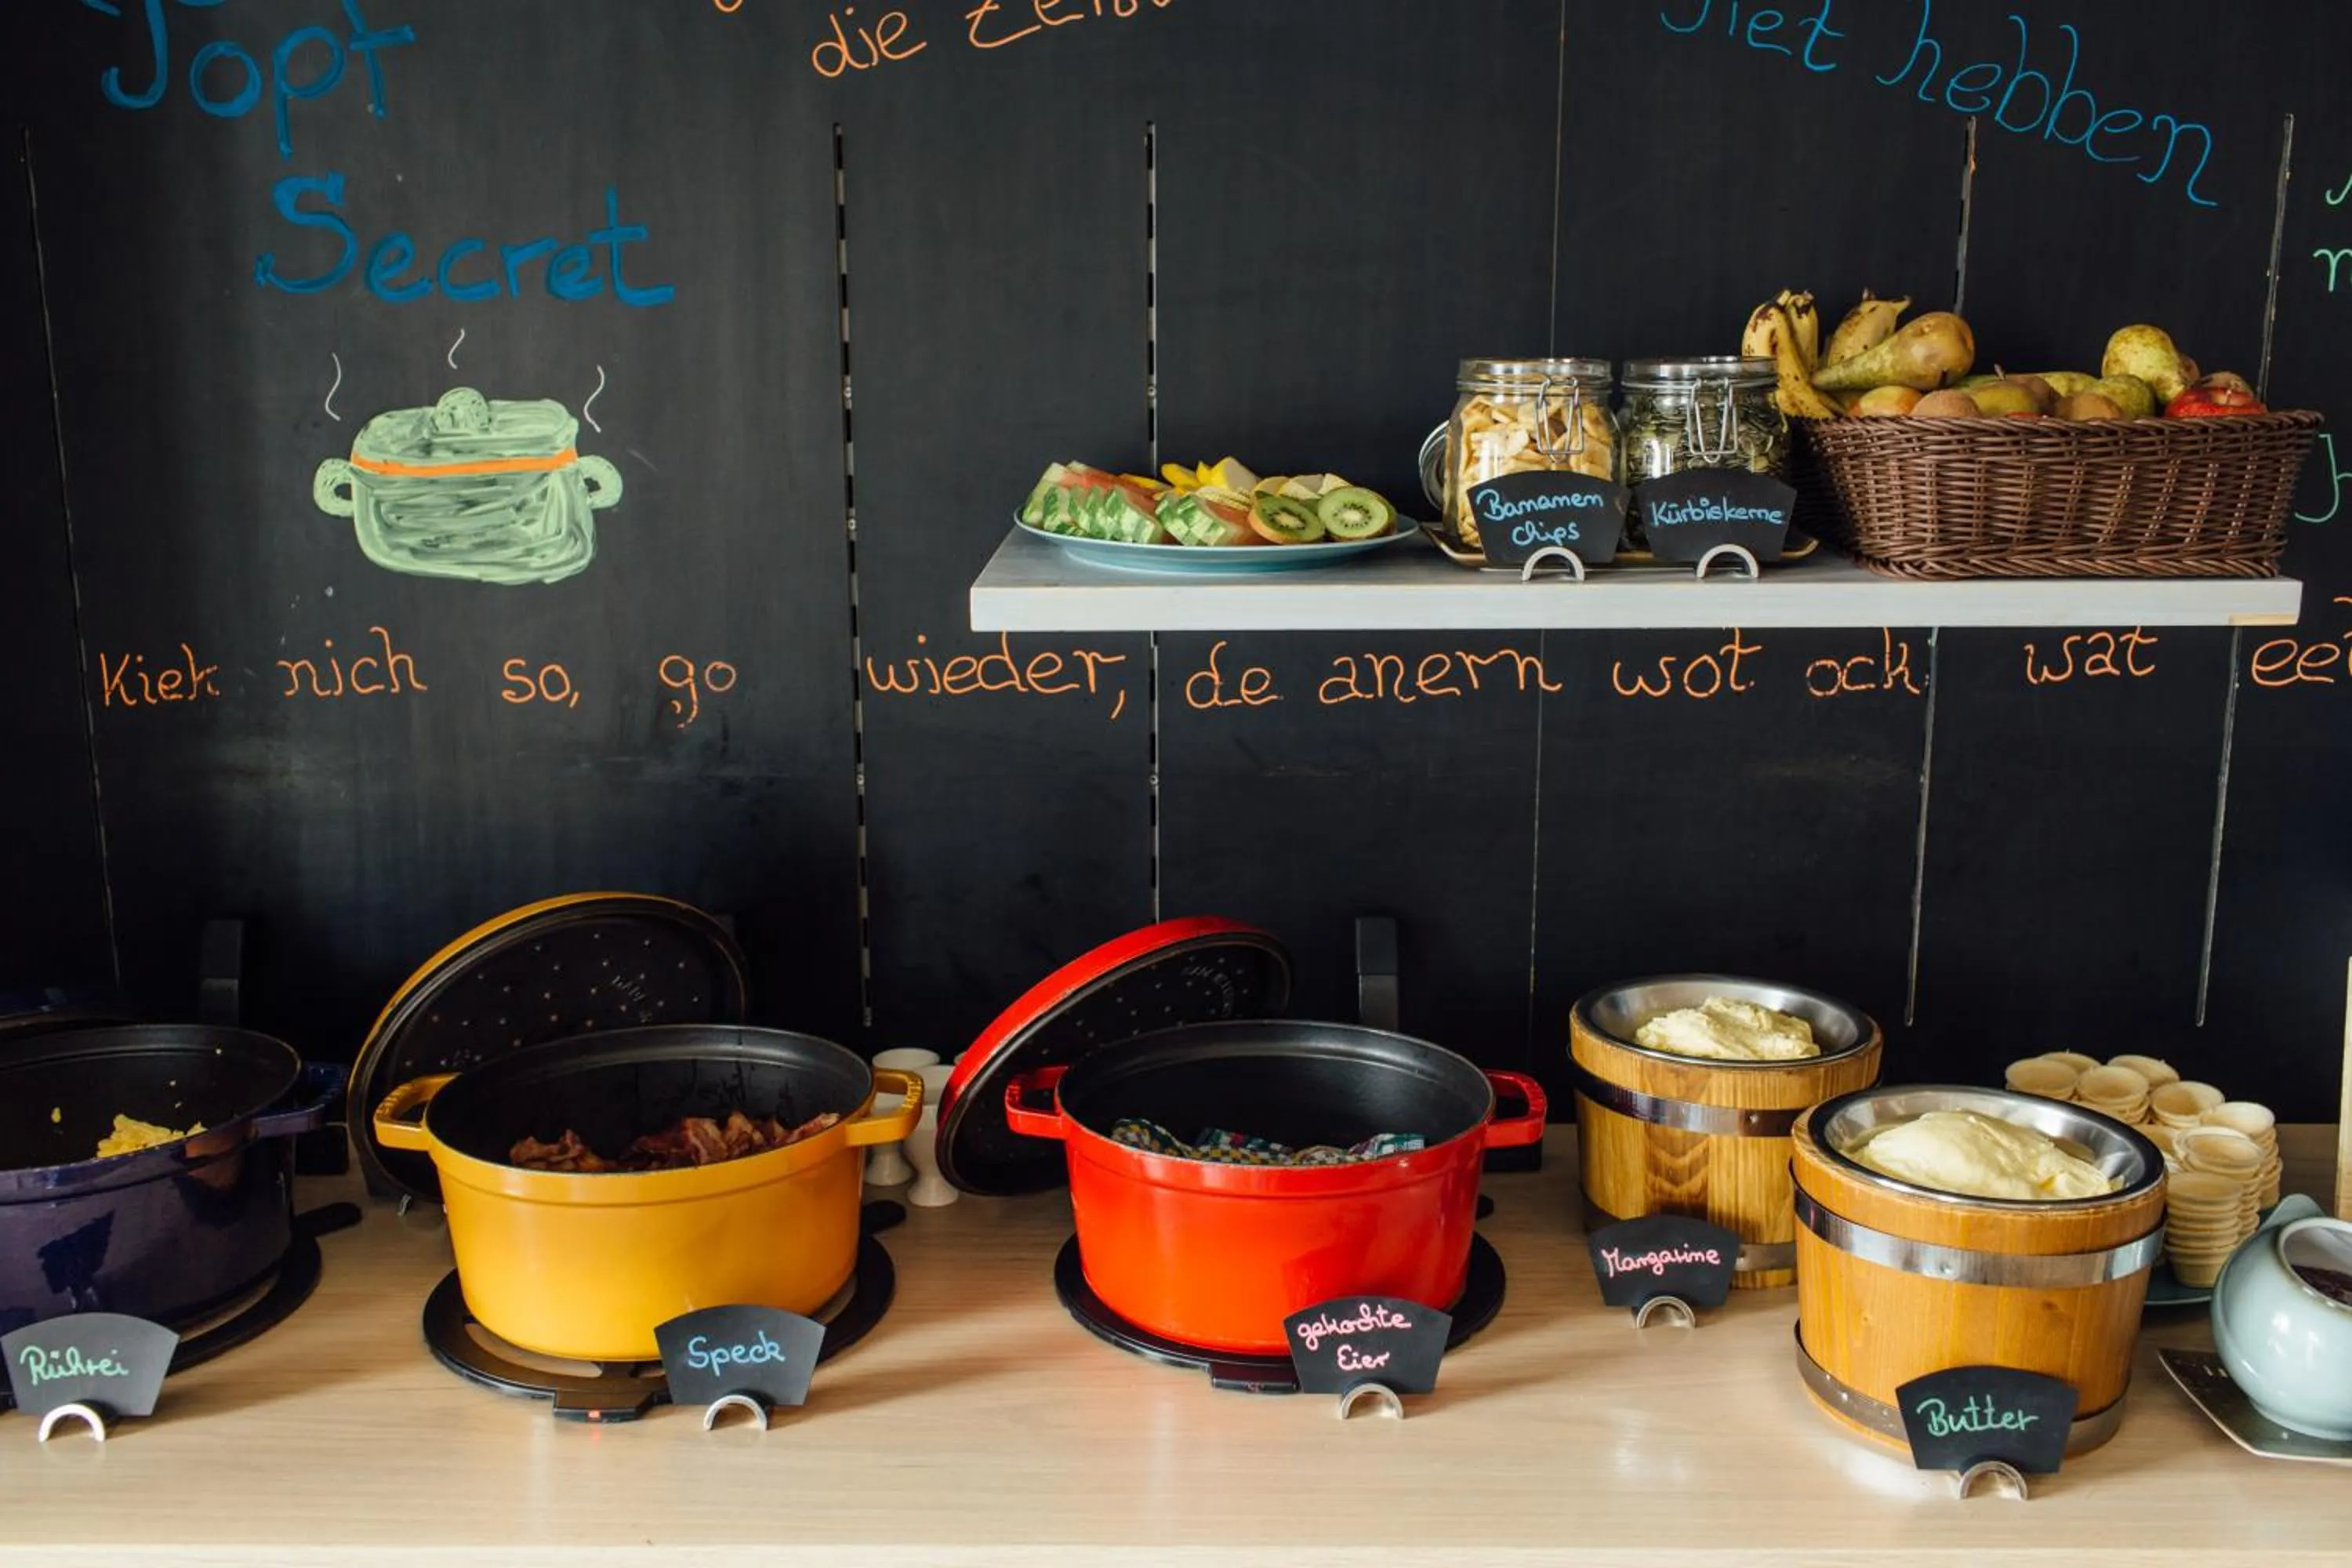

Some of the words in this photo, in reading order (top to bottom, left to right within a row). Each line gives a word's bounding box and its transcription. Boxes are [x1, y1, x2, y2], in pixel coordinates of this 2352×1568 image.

[811, 6, 928, 78] die
[1875, 0, 2220, 207] hebben
[255, 172, 676, 307] Secret
[1650, 496, 1784, 527] Kürbiskerne
[100, 642, 221, 707] Kiek
[277, 626, 427, 698] nich
[501, 658, 579, 709] so,
[659, 655, 737, 728] go
[866, 630, 1127, 720] wieder,
[1185, 641, 1278, 709] de
[1319, 649, 1563, 705] anern
[1613, 628, 1763, 699] wot
[1806, 628, 1920, 698] ock
[2024, 627, 2158, 684] wat
[2251, 630, 2352, 688] ee
[1601, 1242, 1722, 1278] Margarine
[1297, 1302, 1412, 1352] gekochte
[20, 1345, 129, 1386] Rührei
[687, 1330, 786, 1377] Speck
[1336, 1344, 1391, 1371] Eier
[1915, 1394, 2040, 1437] Butter
